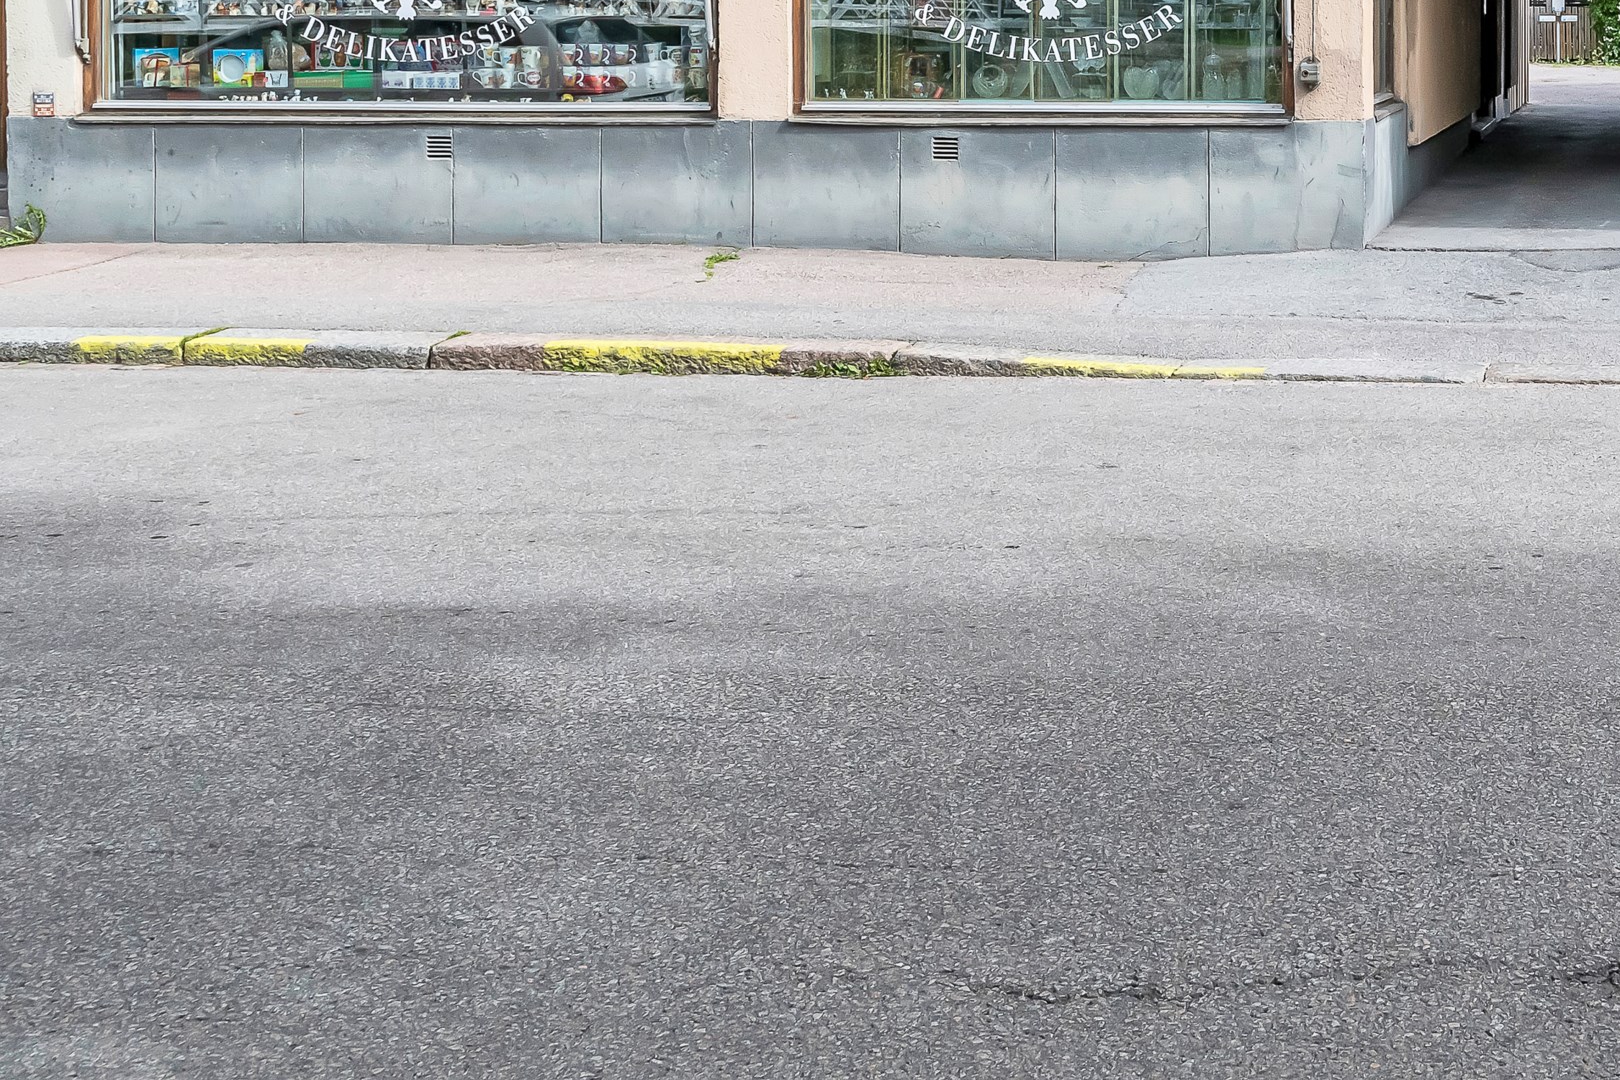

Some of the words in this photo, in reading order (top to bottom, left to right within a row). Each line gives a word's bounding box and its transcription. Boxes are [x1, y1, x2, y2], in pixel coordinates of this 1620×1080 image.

[275, 4, 296, 27] &
[300, 6, 536, 63] DELIKATESSER
[915, 3, 936, 27] &
[940, 3, 1184, 63] DELIKATESSER
